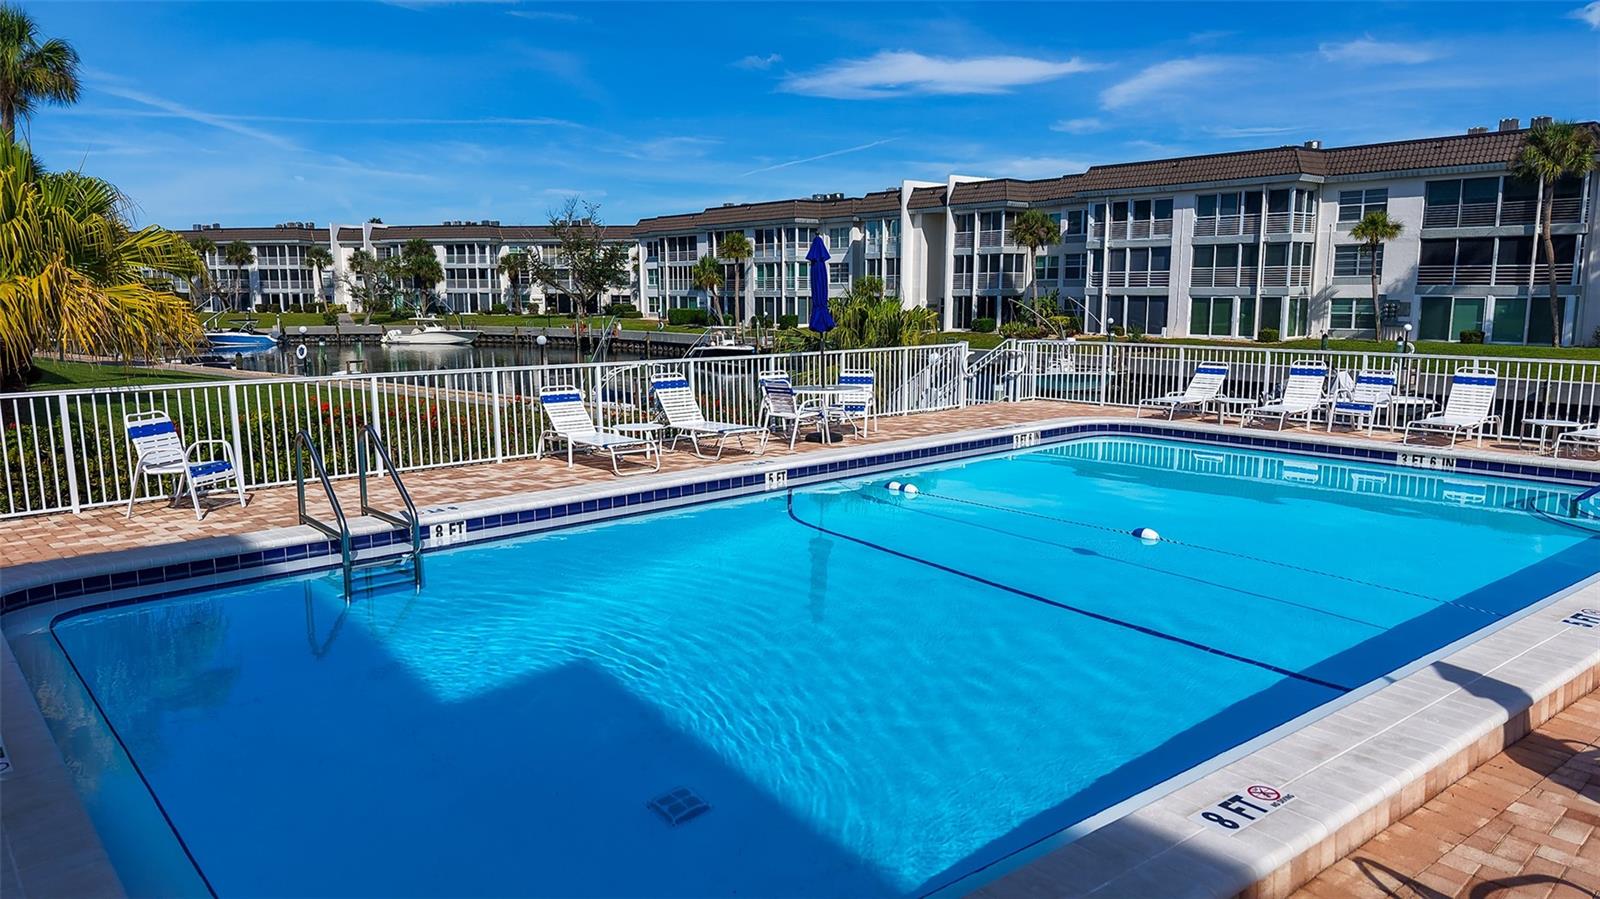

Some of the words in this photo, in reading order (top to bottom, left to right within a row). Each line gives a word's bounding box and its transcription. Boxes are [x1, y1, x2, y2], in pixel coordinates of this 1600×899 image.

[1401, 453, 1408, 463] 3
[1412, 454, 1425, 464] FT
[1430, 456, 1437, 466] 6
[1442, 457, 1454, 467] IN
[768, 473, 774, 483] 5
[777, 471, 786, 482] FT
[435, 524, 444, 538] 8
[449, 520, 464, 536] FT
[1570, 612, 1600, 624] FT
[1217, 794, 1268, 821] FT
[1201, 811, 1240, 830] 8
